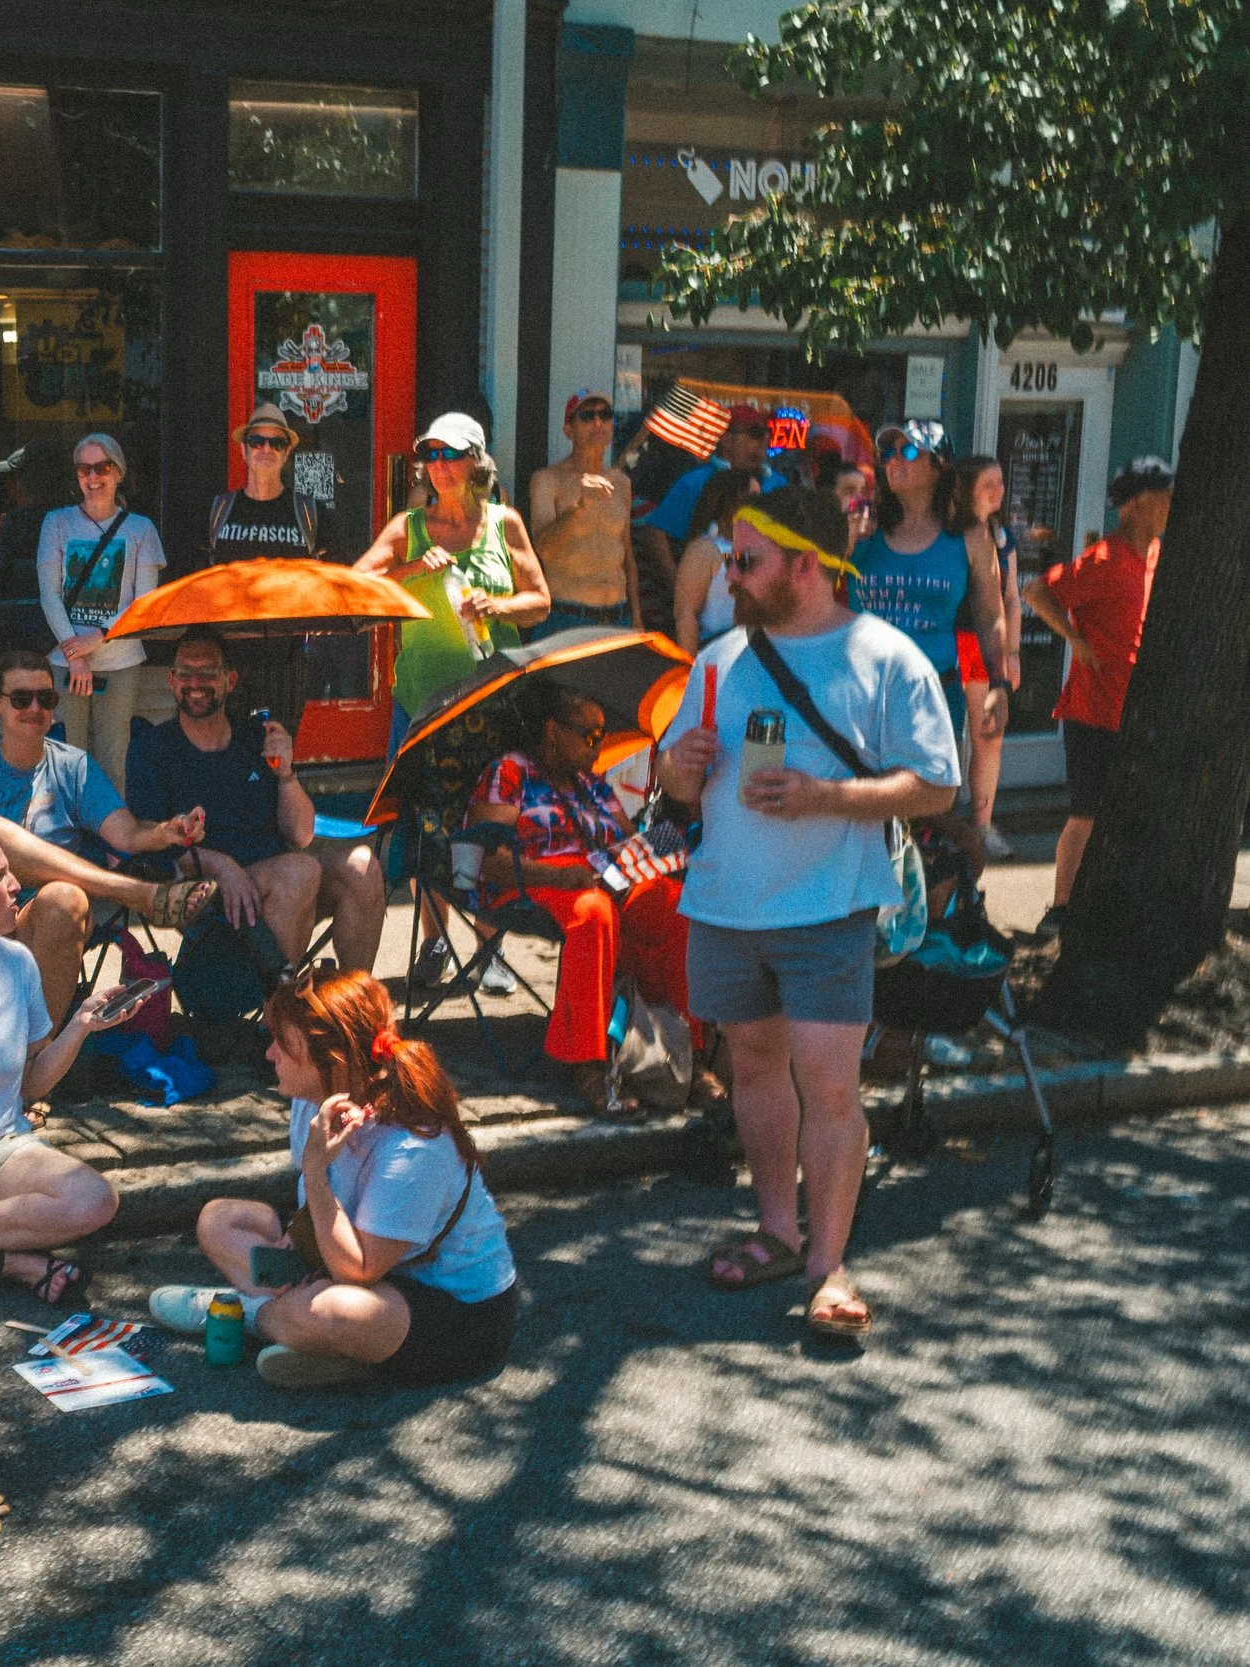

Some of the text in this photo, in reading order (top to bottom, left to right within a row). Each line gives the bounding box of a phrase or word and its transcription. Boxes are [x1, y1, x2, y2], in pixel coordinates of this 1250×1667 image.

[258, 371, 368, 390] FADE KINGZ
[1010, 361, 1058, 392] 4206
